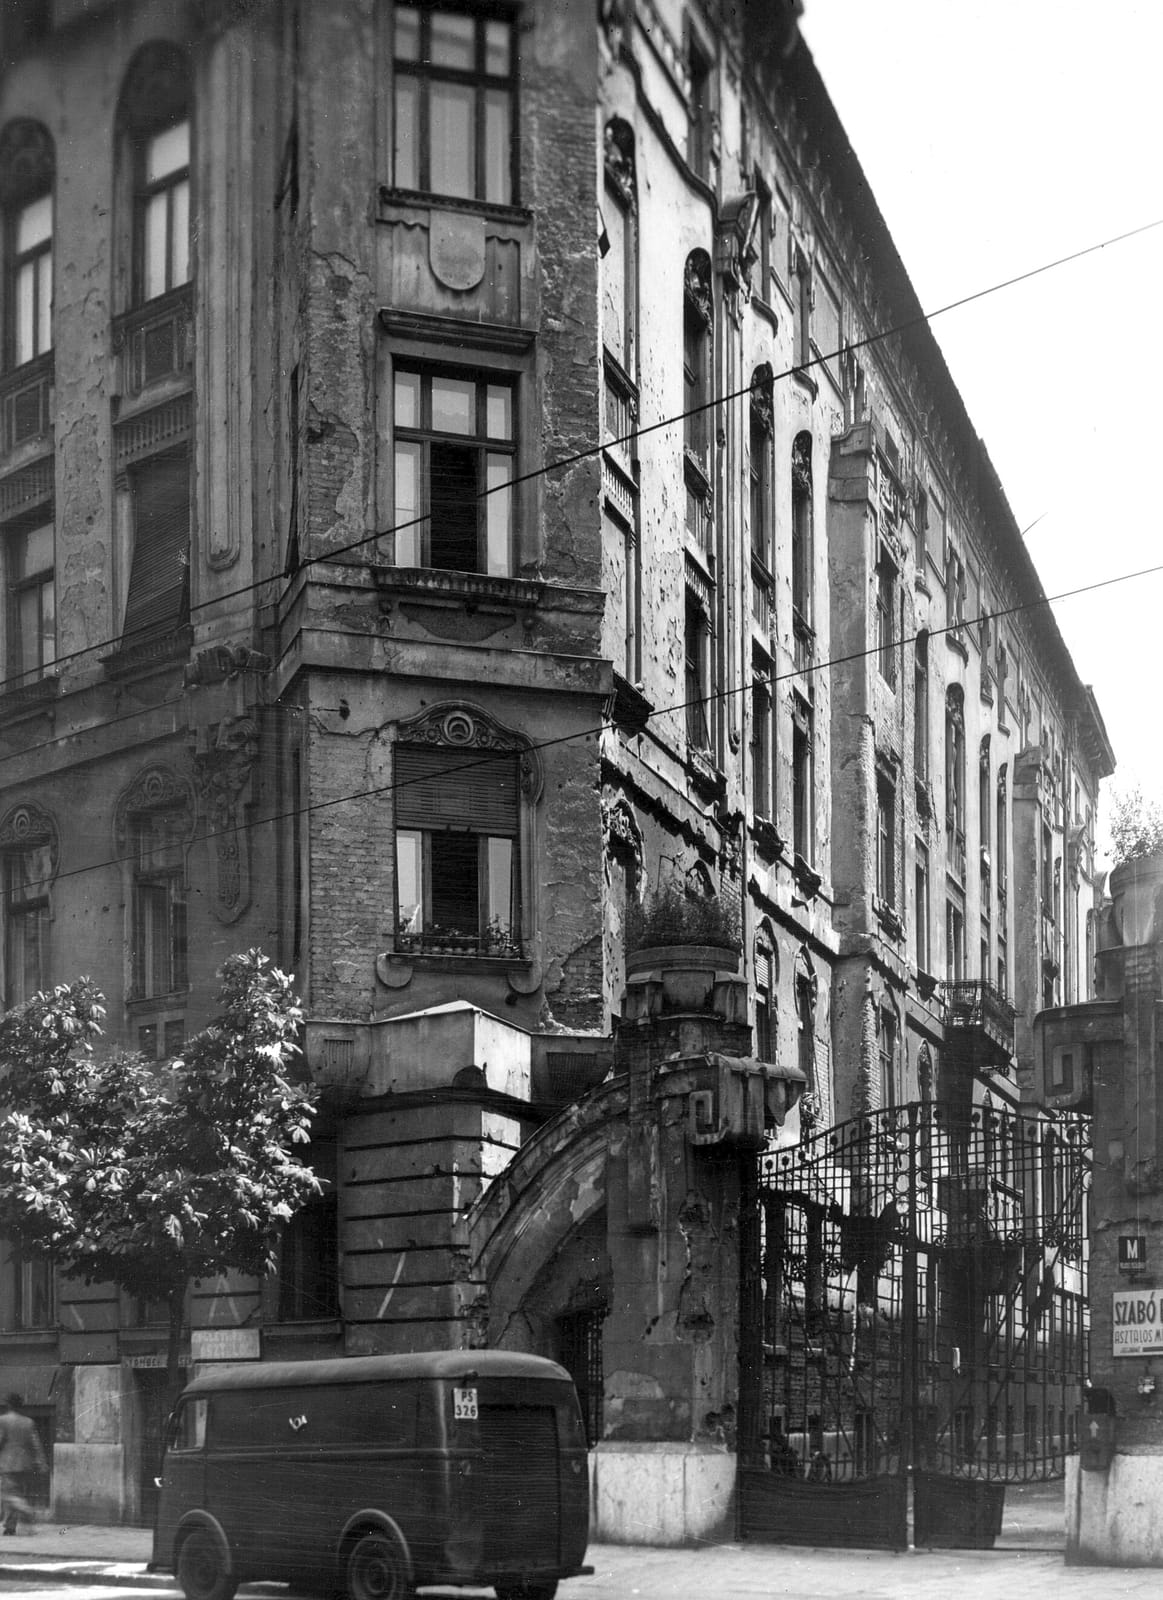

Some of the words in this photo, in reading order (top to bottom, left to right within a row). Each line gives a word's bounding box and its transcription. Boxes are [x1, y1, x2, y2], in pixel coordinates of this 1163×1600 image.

[1127, 1239, 1138, 1259] M
[1114, 1291, 1156, 1326] SZABÓ
[1114, 1329, 1153, 1345] ASZTALOS
